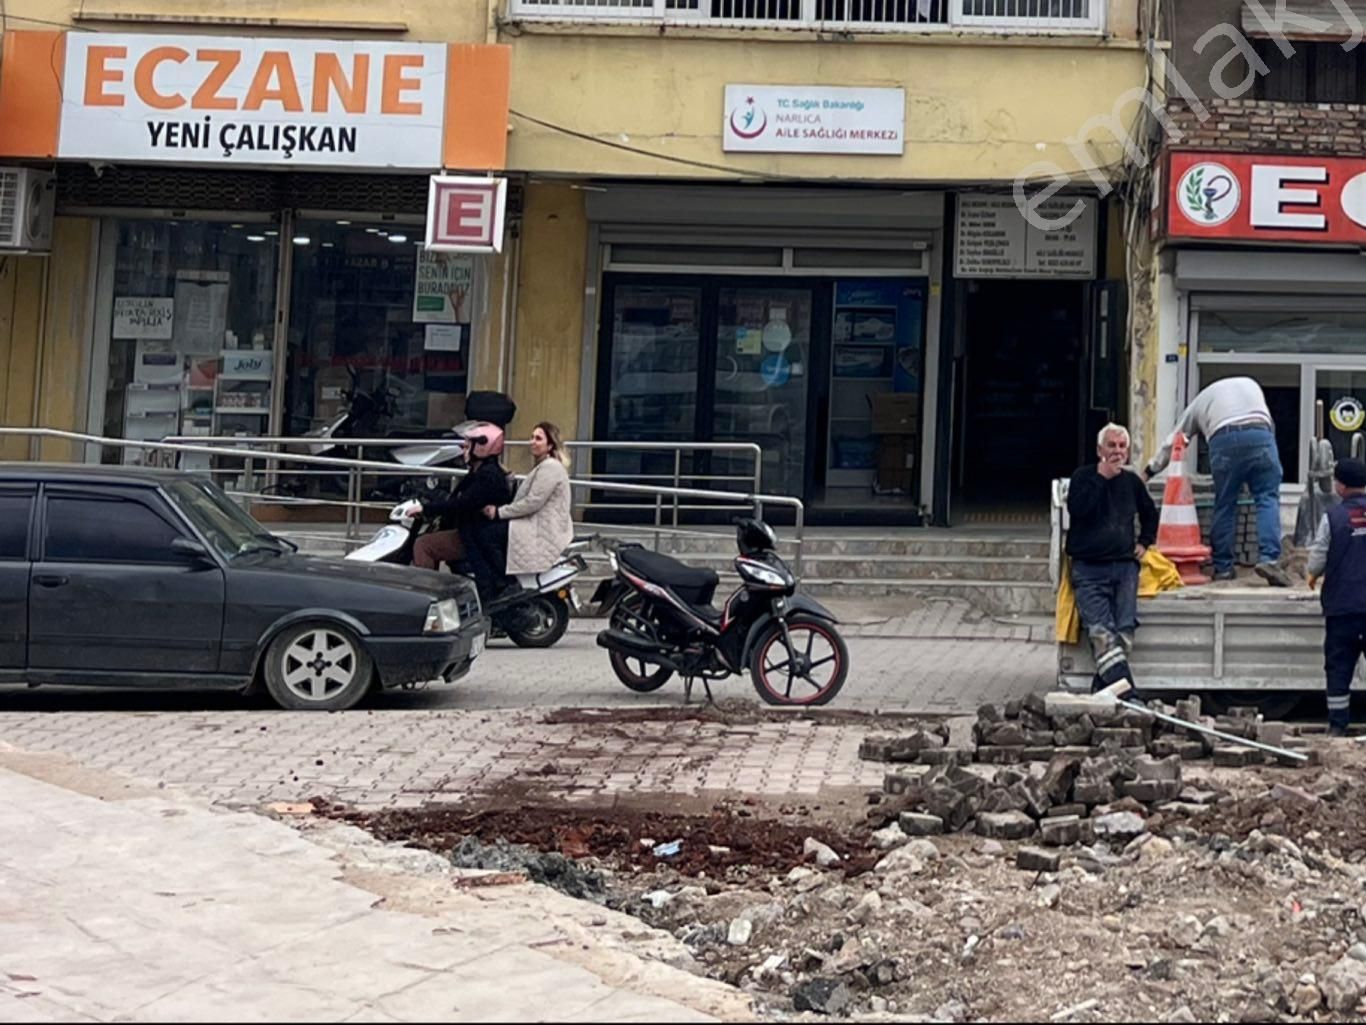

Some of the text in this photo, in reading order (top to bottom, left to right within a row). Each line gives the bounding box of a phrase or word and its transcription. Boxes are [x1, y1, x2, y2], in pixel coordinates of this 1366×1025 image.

[84, 45, 424, 115] ECZANE
[147, 115, 357, 158] YENİ ÇALIŞKAN
[775, 127, 898, 141] AİLE SAĞLIĞI MERKEZİ
[446, 193, 485, 238] E
